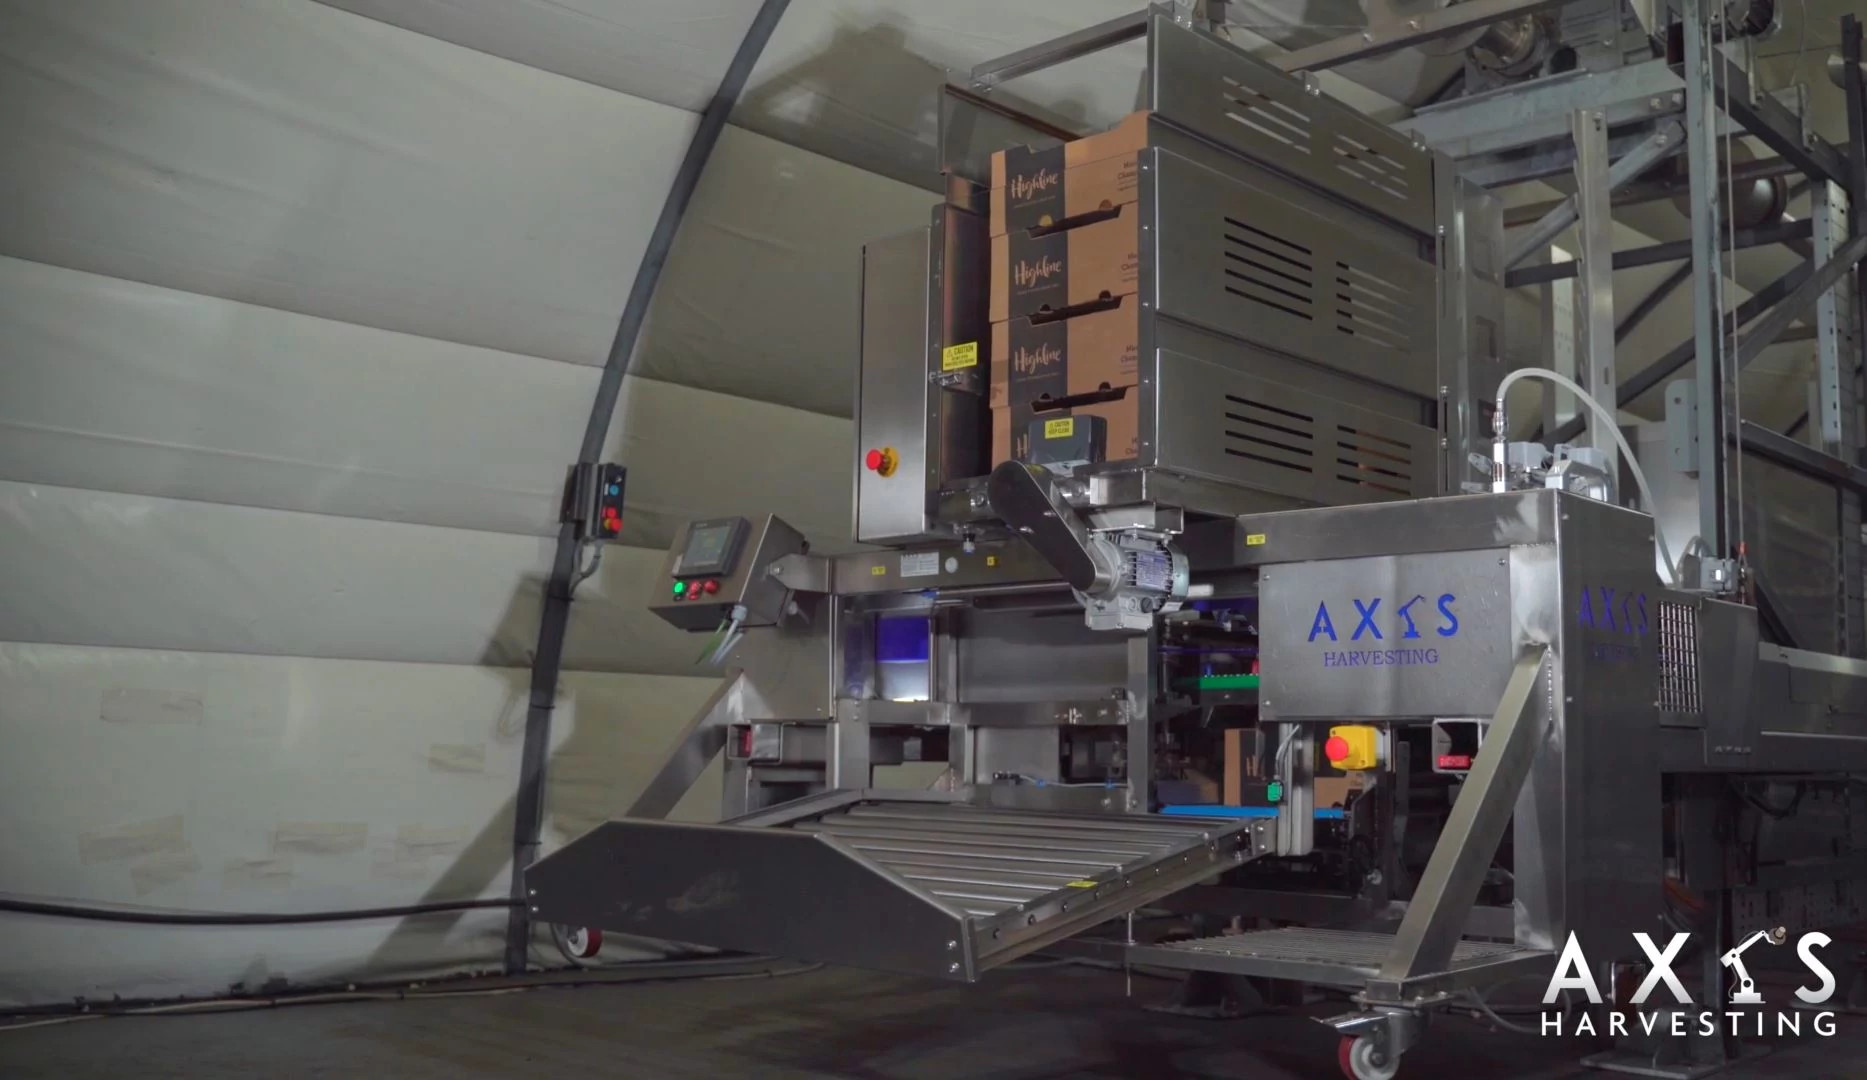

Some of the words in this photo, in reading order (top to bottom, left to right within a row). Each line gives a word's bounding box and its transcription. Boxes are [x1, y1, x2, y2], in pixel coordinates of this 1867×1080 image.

[1011, 168, 1058, 200] Highline
[1015, 255, 1062, 288] Highline
[1014, 343, 1061, 374] Highline
[1323, 648, 1440, 667] HARVESTING
